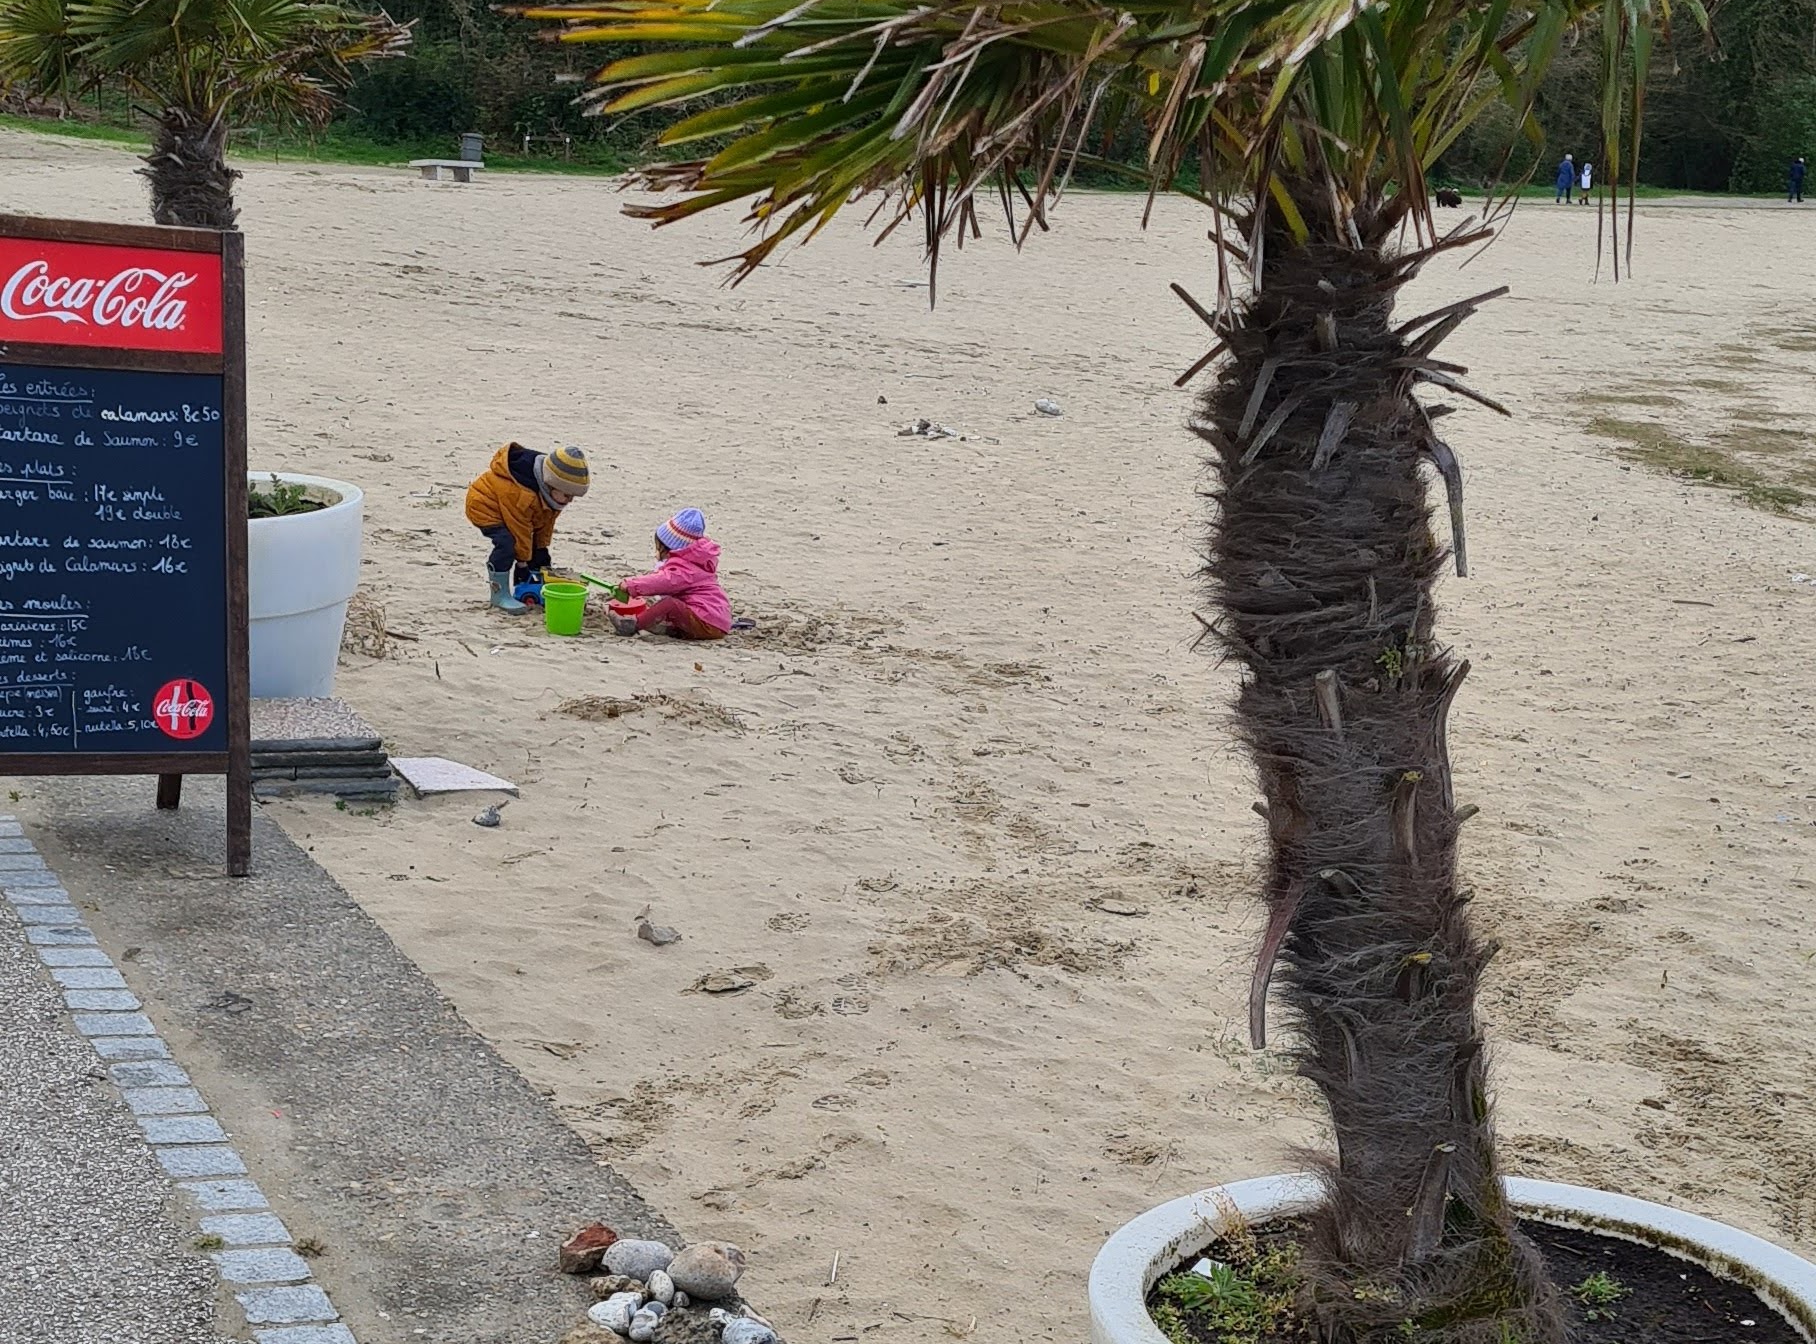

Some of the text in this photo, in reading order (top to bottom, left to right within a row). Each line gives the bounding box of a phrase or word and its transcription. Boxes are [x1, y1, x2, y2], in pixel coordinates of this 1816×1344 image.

[1, 260, 198, 331] Coca-Cola
[74, 430, 94, 446] de
[122, 484, 165, 507] simple
[132, 504, 183, 521] double
[63, 535, 80, 549] de
[39, 557, 57, 573] de
[34, 652, 49, 662] et
